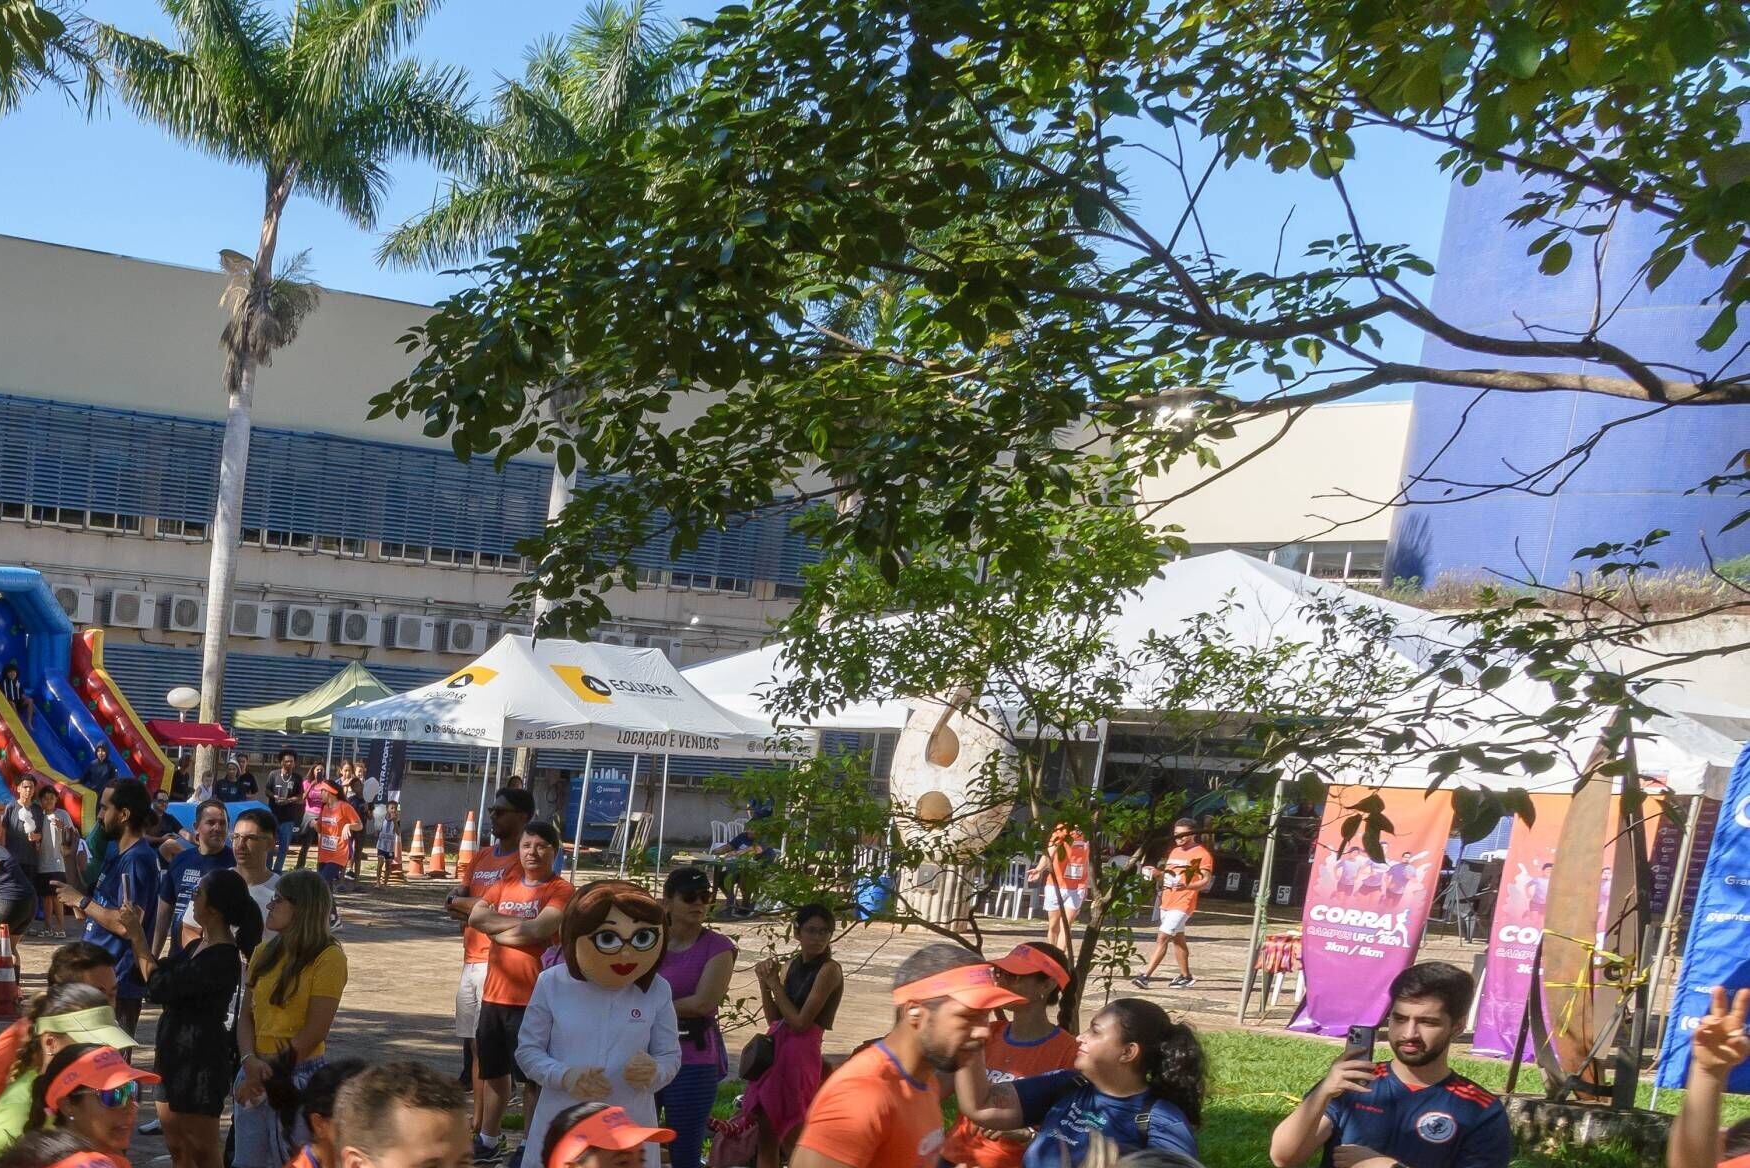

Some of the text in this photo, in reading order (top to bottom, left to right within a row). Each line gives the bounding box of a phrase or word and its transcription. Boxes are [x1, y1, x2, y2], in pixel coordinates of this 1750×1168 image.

[608, 679, 678, 697] EQUIPAR
[373, 719, 379, 730] E
[379, 719, 408, 732] VENDAS
[670, 733, 677, 746] E
[679, 734, 719, 750] VENDAS
[1309, 904, 1392, 930] CORRA
[1307, 925, 1402, 946] CAMPUS UFG 2024
[1325, 941, 1349, 953] 3km
